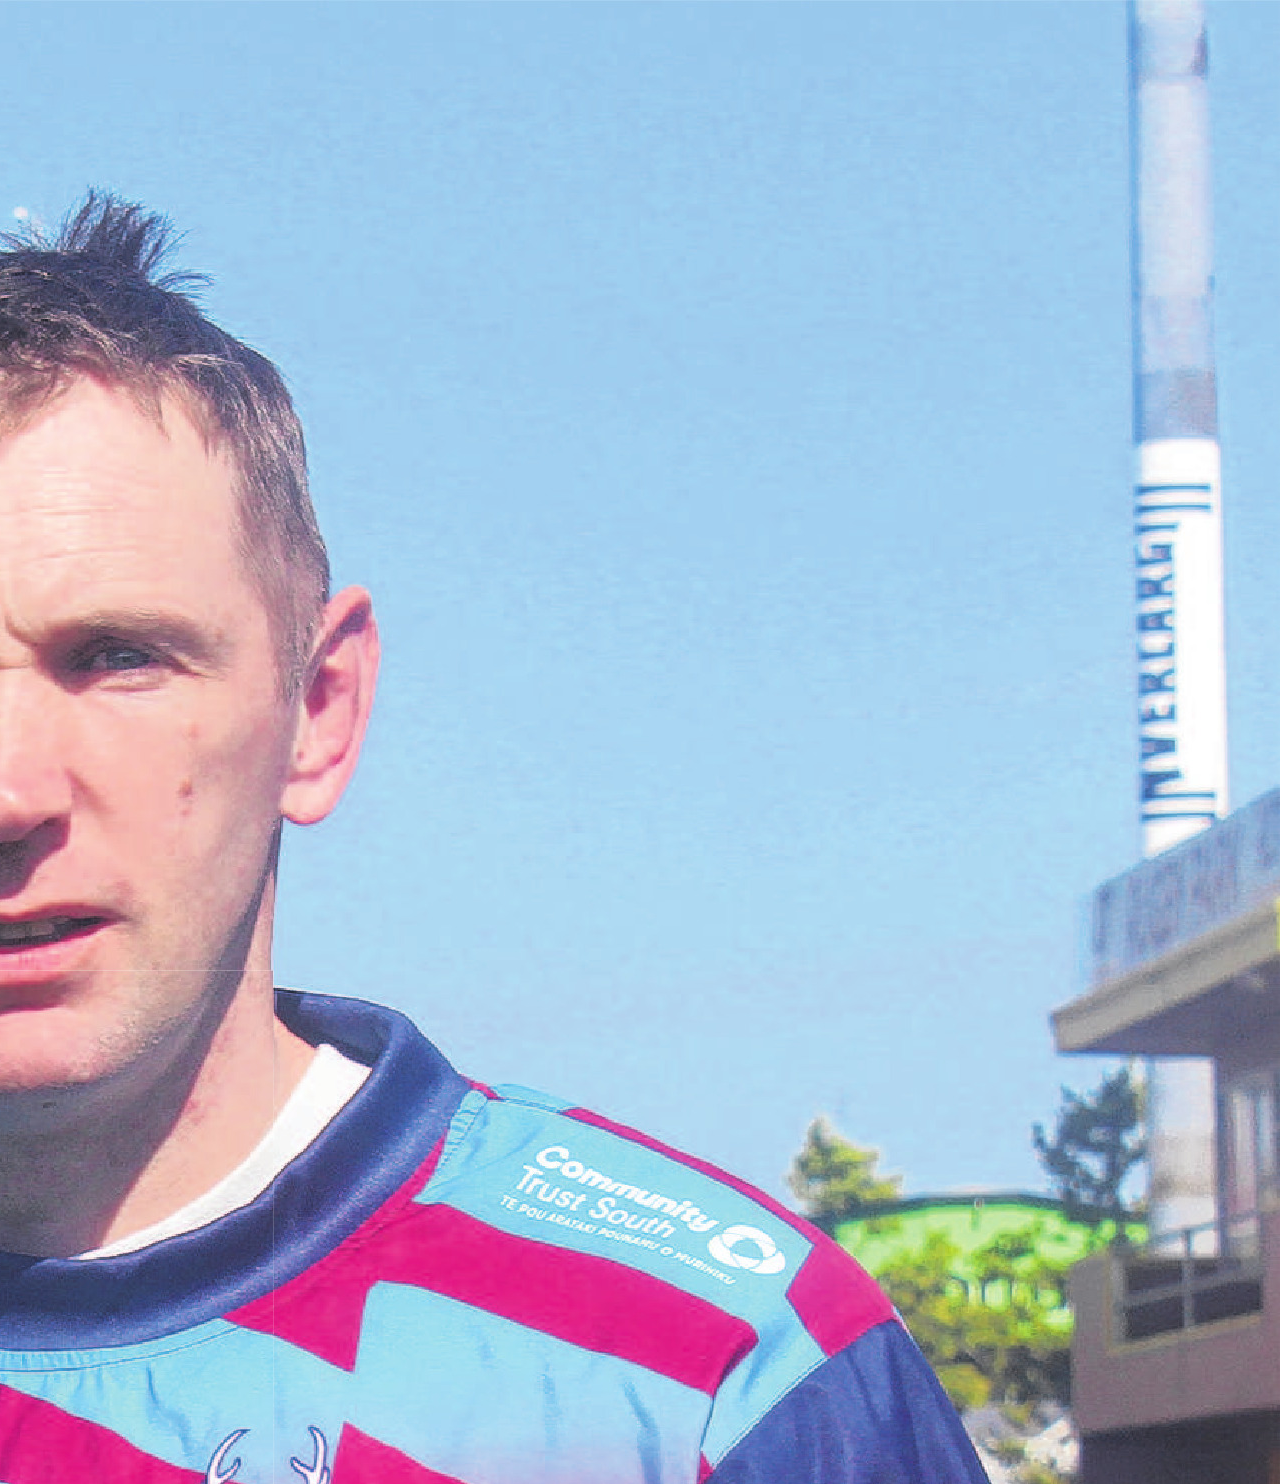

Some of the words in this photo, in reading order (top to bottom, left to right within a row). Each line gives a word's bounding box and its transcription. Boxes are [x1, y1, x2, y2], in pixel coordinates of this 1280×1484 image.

[500, 1195, 515, 1210] TE
[516, 1165, 587, 1211] Trust
[589, 1197, 676, 1237] South
[536, 1146, 719, 1231] Community
